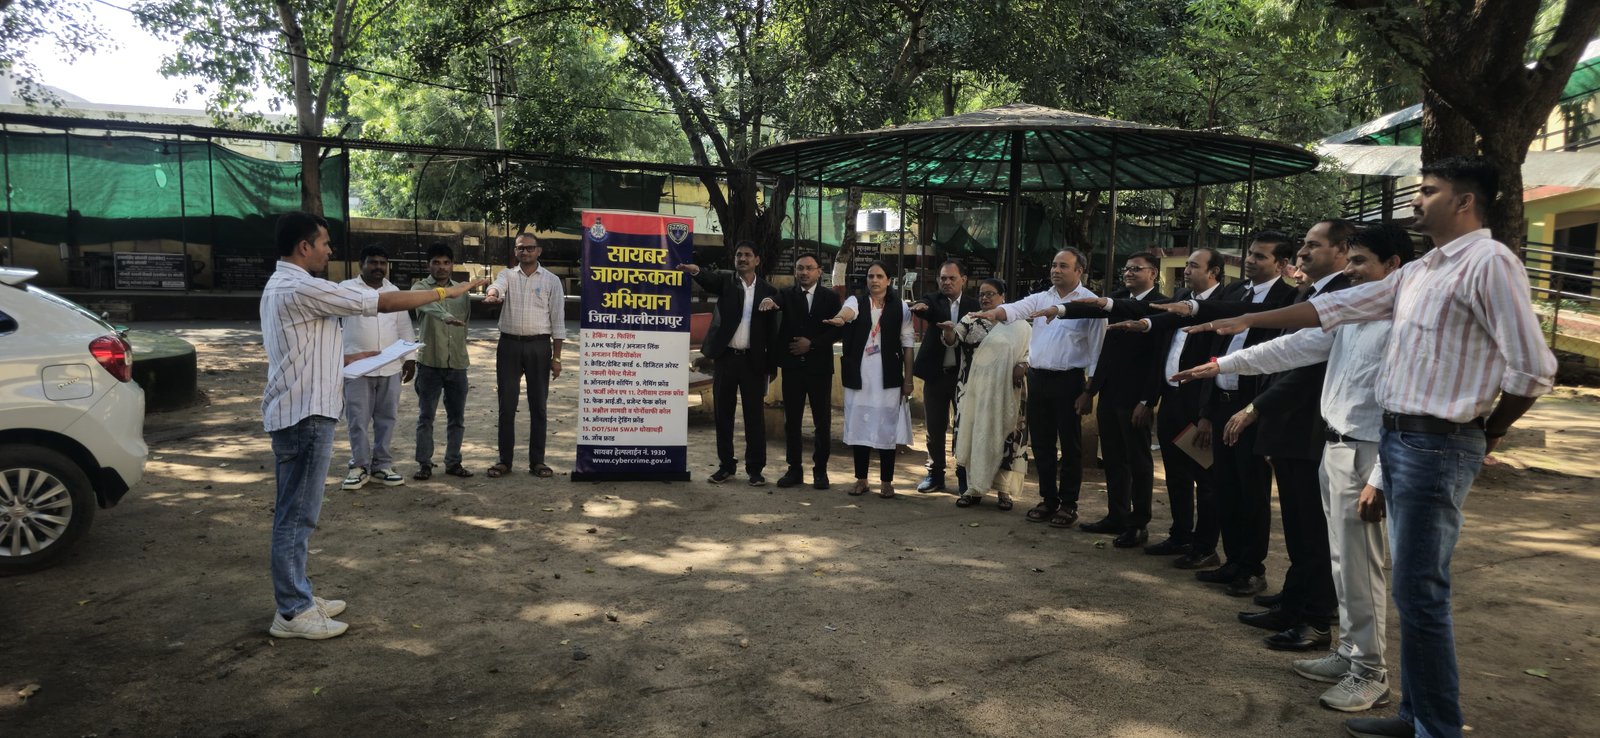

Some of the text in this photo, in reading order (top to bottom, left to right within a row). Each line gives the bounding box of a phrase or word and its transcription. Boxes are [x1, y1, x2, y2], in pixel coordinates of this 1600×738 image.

[607, 246, 668, 264] सायबर
[590, 266, 684, 286] जागरूकता
[601, 288, 672, 310] अभियान
[588, 310, 683, 328] जिला-आलीराजपुर
[592, 457, 671, 465] www.cybercrime.gov.in
